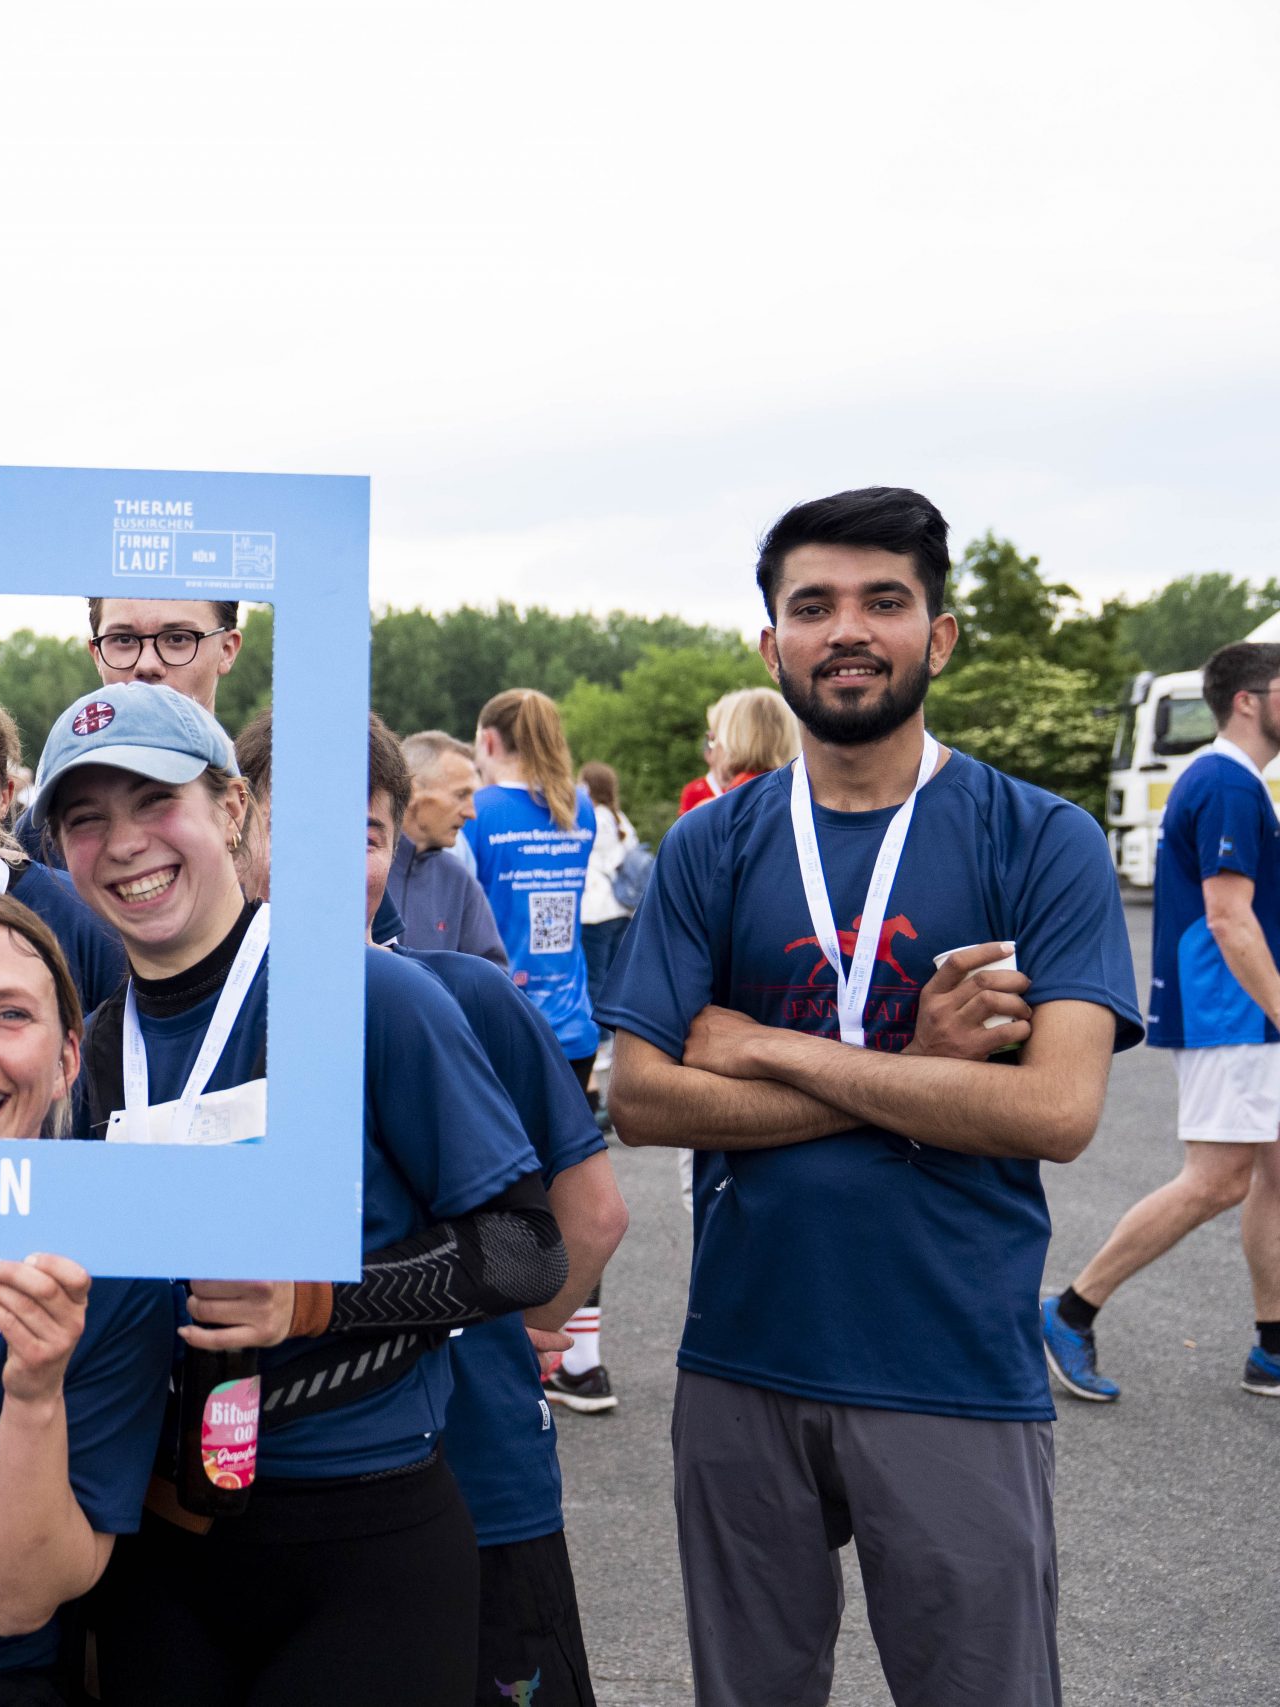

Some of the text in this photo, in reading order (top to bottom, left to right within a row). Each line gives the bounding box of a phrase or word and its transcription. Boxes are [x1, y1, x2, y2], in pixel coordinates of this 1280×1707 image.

[114, 500, 193, 516] THERME
[113, 517, 194, 530] EUSKIRCHEN
[120, 535, 169, 549] FIRMEN
[120, 551, 168, 571] LAUF
